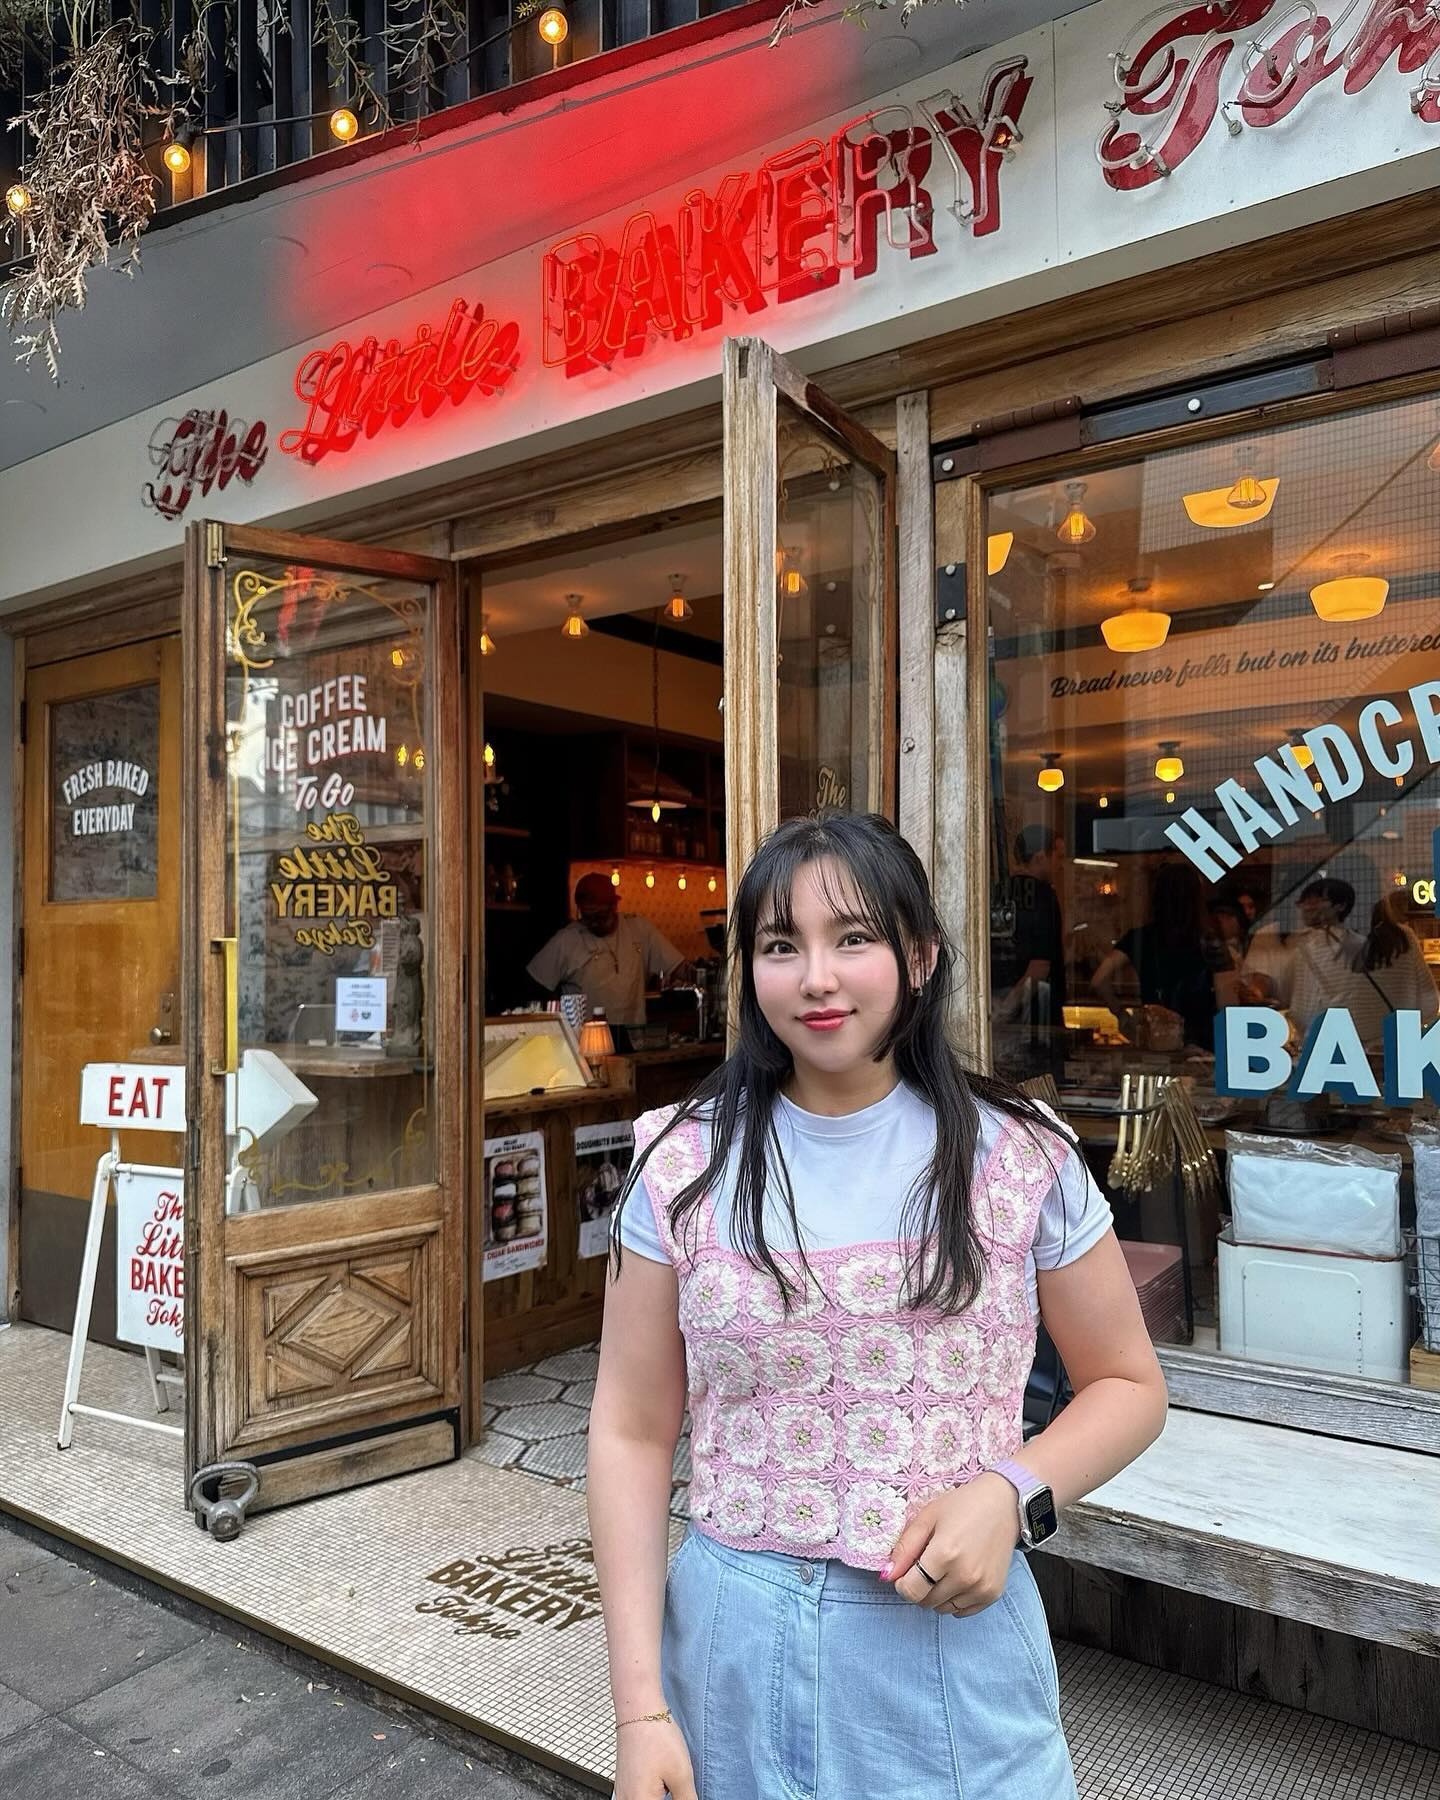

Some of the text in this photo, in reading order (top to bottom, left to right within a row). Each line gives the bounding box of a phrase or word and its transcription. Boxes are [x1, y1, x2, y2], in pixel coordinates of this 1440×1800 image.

[278, 297, 522, 466] Little
[542, 55, 1034, 379] BAKERY
[1051, 670, 1117, 698] Bread
[1116, 666, 1174, 690] never
[1176, 653, 1231, 688] falls
[1235, 650, 1276, 673] but
[1279, 650, 1310, 669] on
[1312, 641, 1341, 665] its
[281, 674, 368, 729] COFFEE
[265, 715, 387, 773] ICE CREAM
[62, 760, 150, 806] FRESH BAKED
[816, 766, 847, 809] The
[73, 803, 136, 836] EVERYDAY
[108, 1075, 171, 1119] EAT
[154, 1192, 184, 1222] Th
[415, 1595, 522, 1641] Tokyo
[425, 1558, 603, 1632] BAKERY
